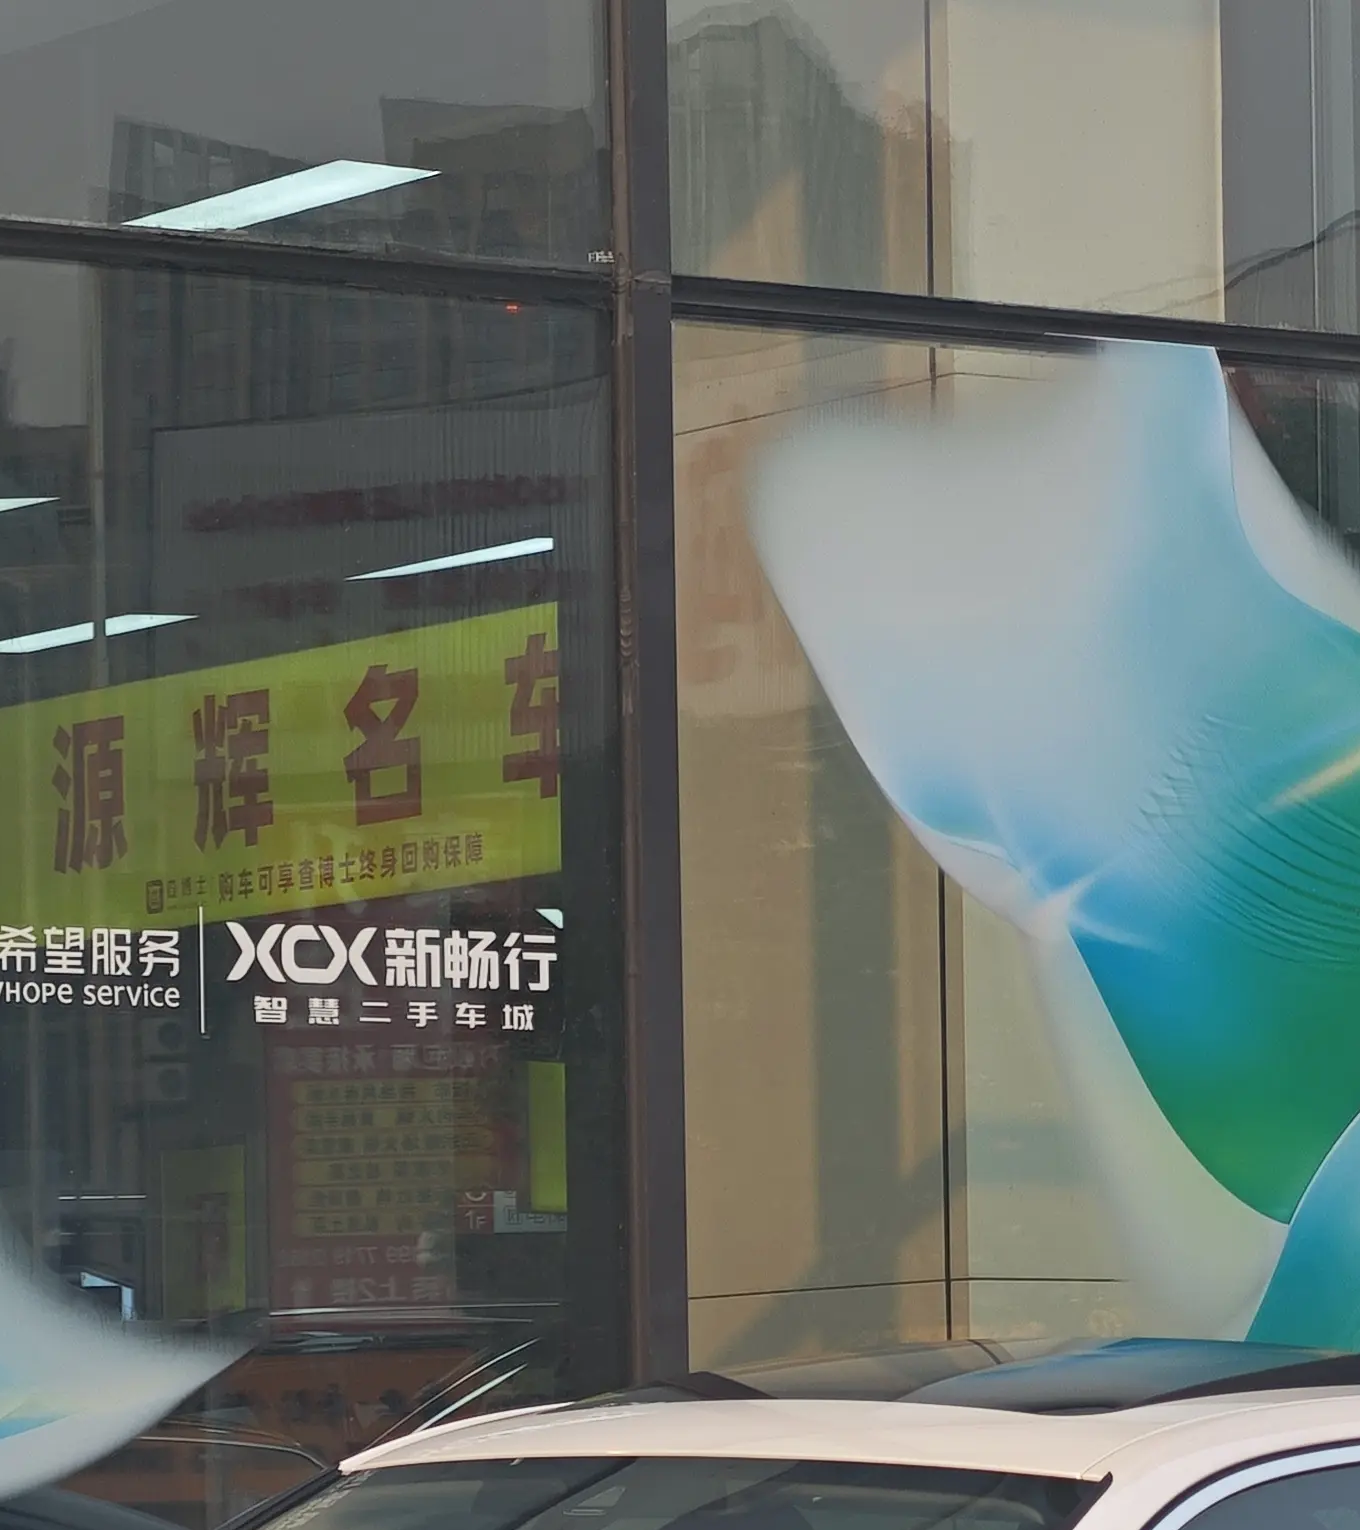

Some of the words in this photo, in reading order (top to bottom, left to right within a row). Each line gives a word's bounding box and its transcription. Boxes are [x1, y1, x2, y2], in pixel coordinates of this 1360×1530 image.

[52, 632, 558, 875] 源辉名车
[217, 832, 485, 904] 购车可享查博士终身回购保障
[253, 994, 535, 1032] 智慧二手车城
